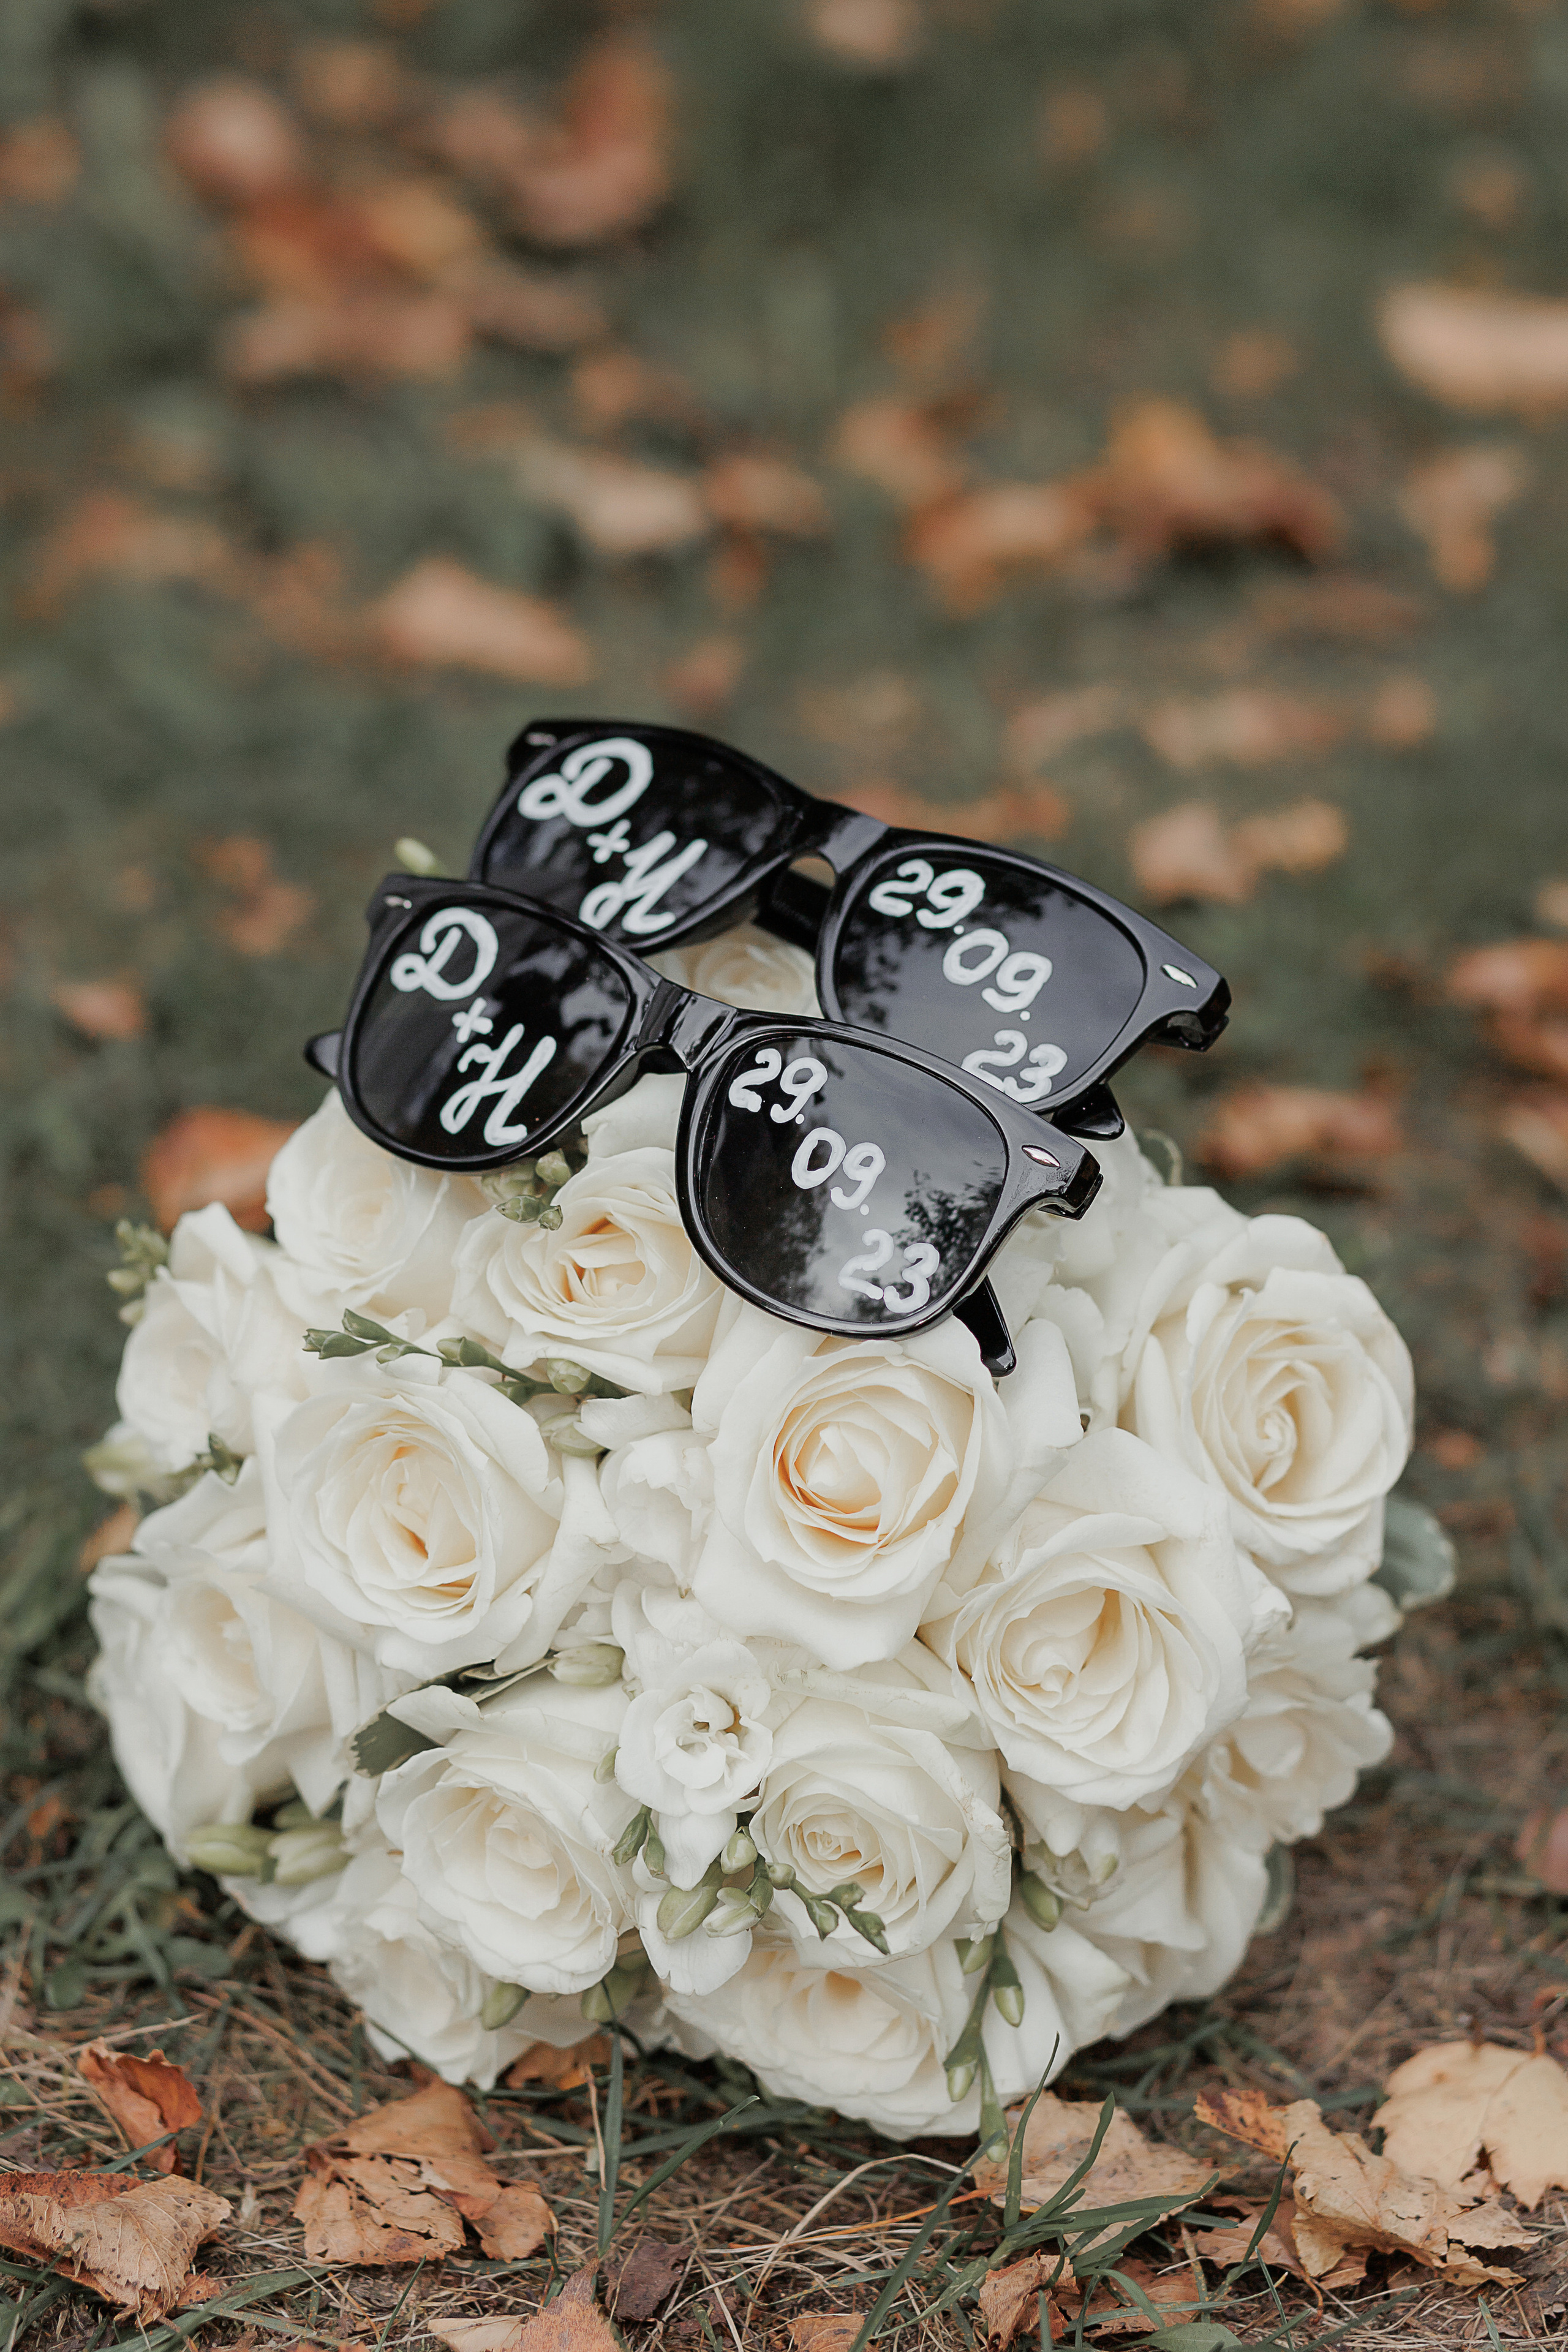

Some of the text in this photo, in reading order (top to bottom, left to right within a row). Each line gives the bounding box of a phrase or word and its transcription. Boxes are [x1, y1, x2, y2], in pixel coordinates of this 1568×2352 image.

[518, 737, 654, 827] D
[869, 859, 986, 935] 29.
[390, 907, 499, 1001] D
[942, 928, 1053, 1021] 09.
[439, 1023, 557, 1147] H
[728, 1048, 827, 1125] 29.
[960, 1029, 1068, 1102] 23
[791, 1127, 886, 1215] 09.
[838, 1229, 940, 1313] 23
